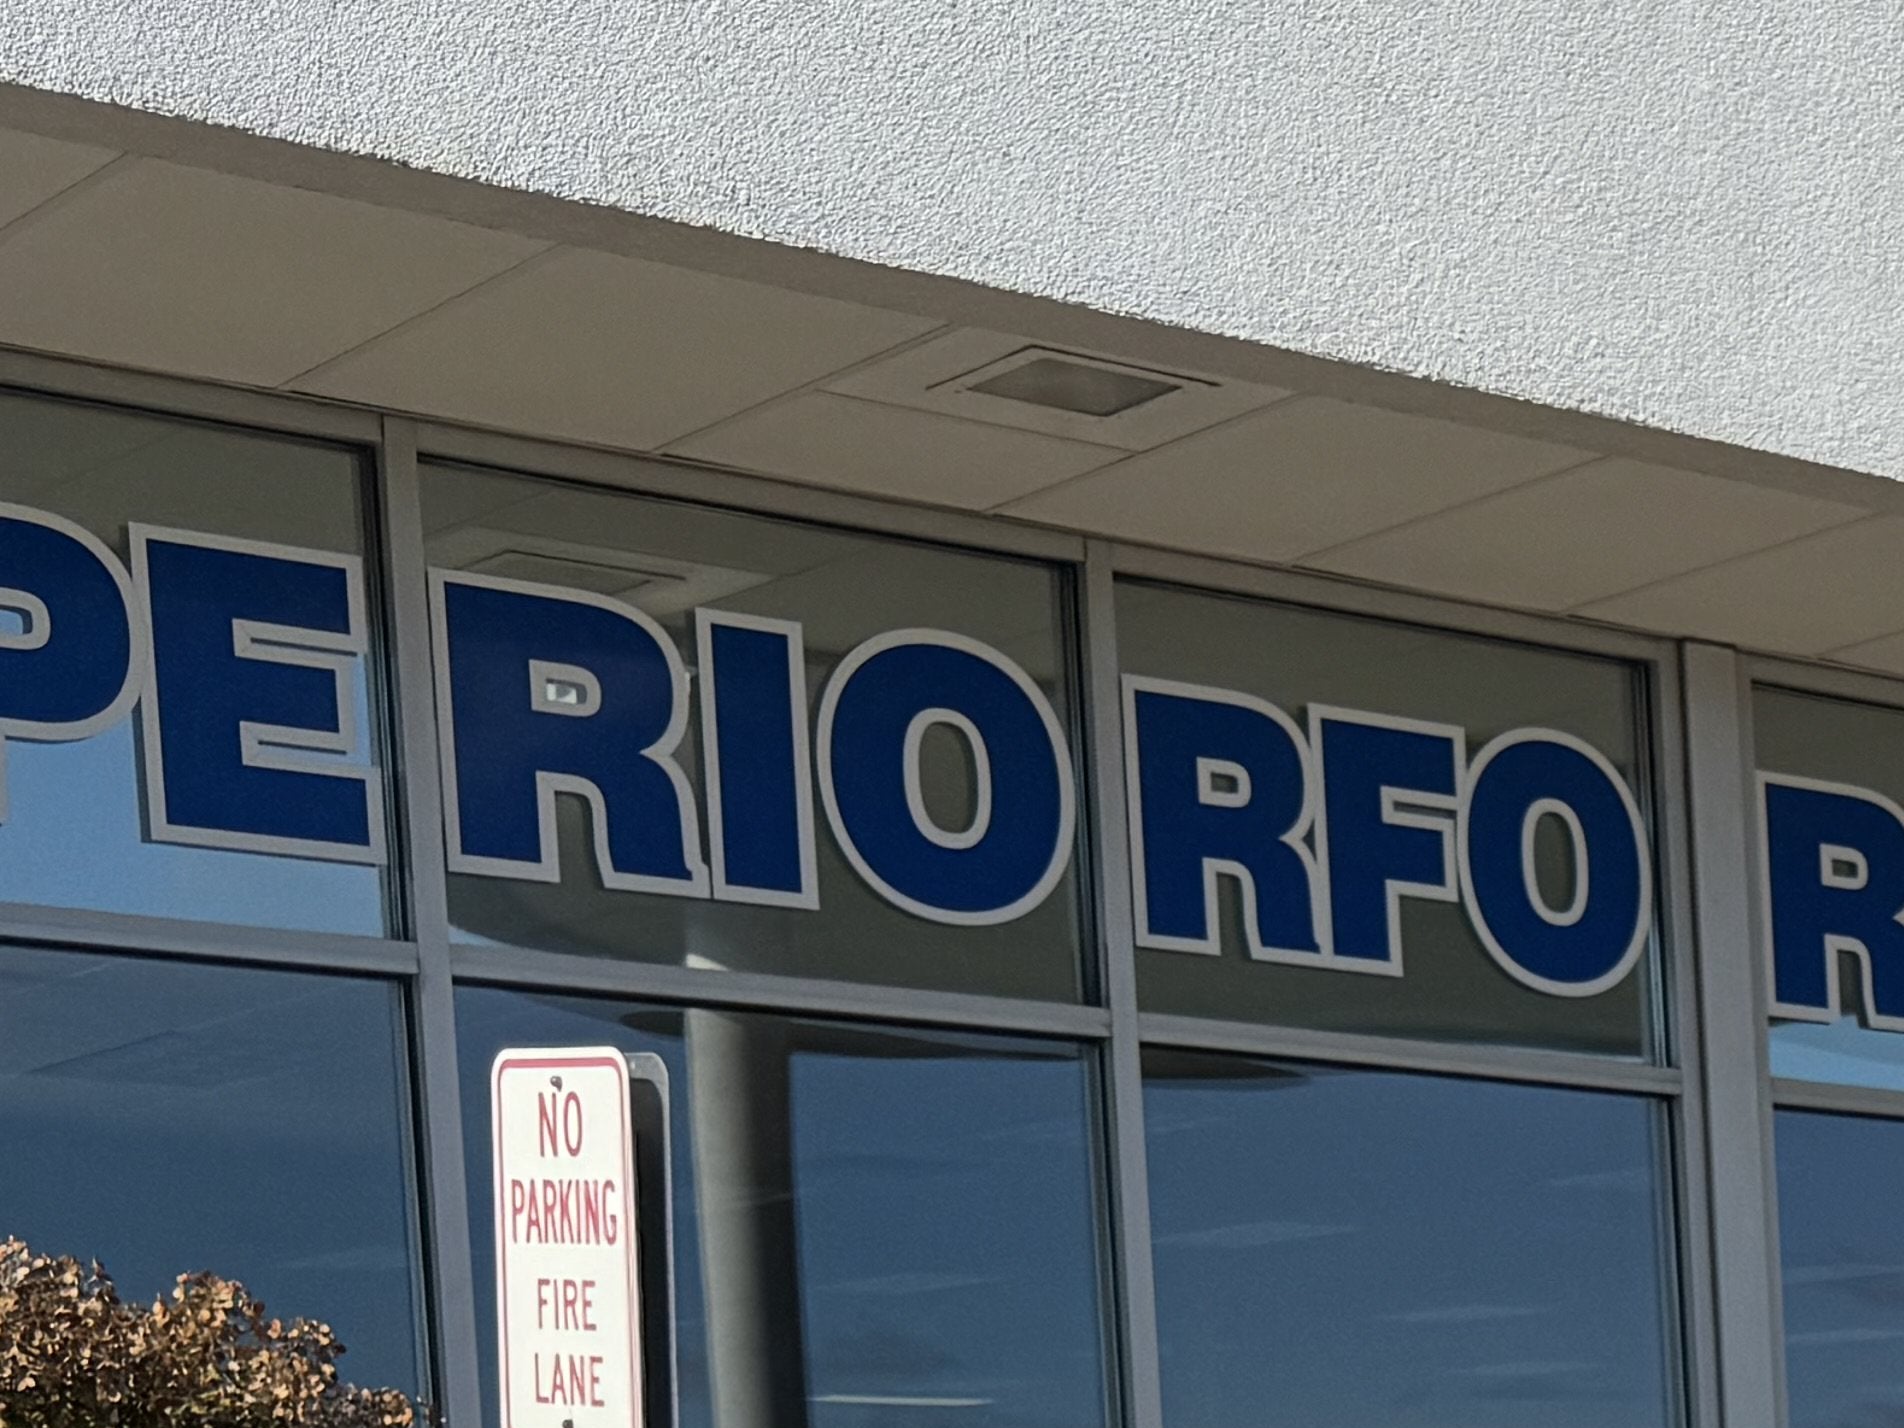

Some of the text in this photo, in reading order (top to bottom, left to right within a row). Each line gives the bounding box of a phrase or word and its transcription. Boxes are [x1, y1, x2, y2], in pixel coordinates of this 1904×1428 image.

[537, 1091, 583, 1158] NO
[511, 1179, 617, 1246] PARKING
[537, 1278, 597, 1331] FIRE
[534, 1353, 604, 1407] LANE
